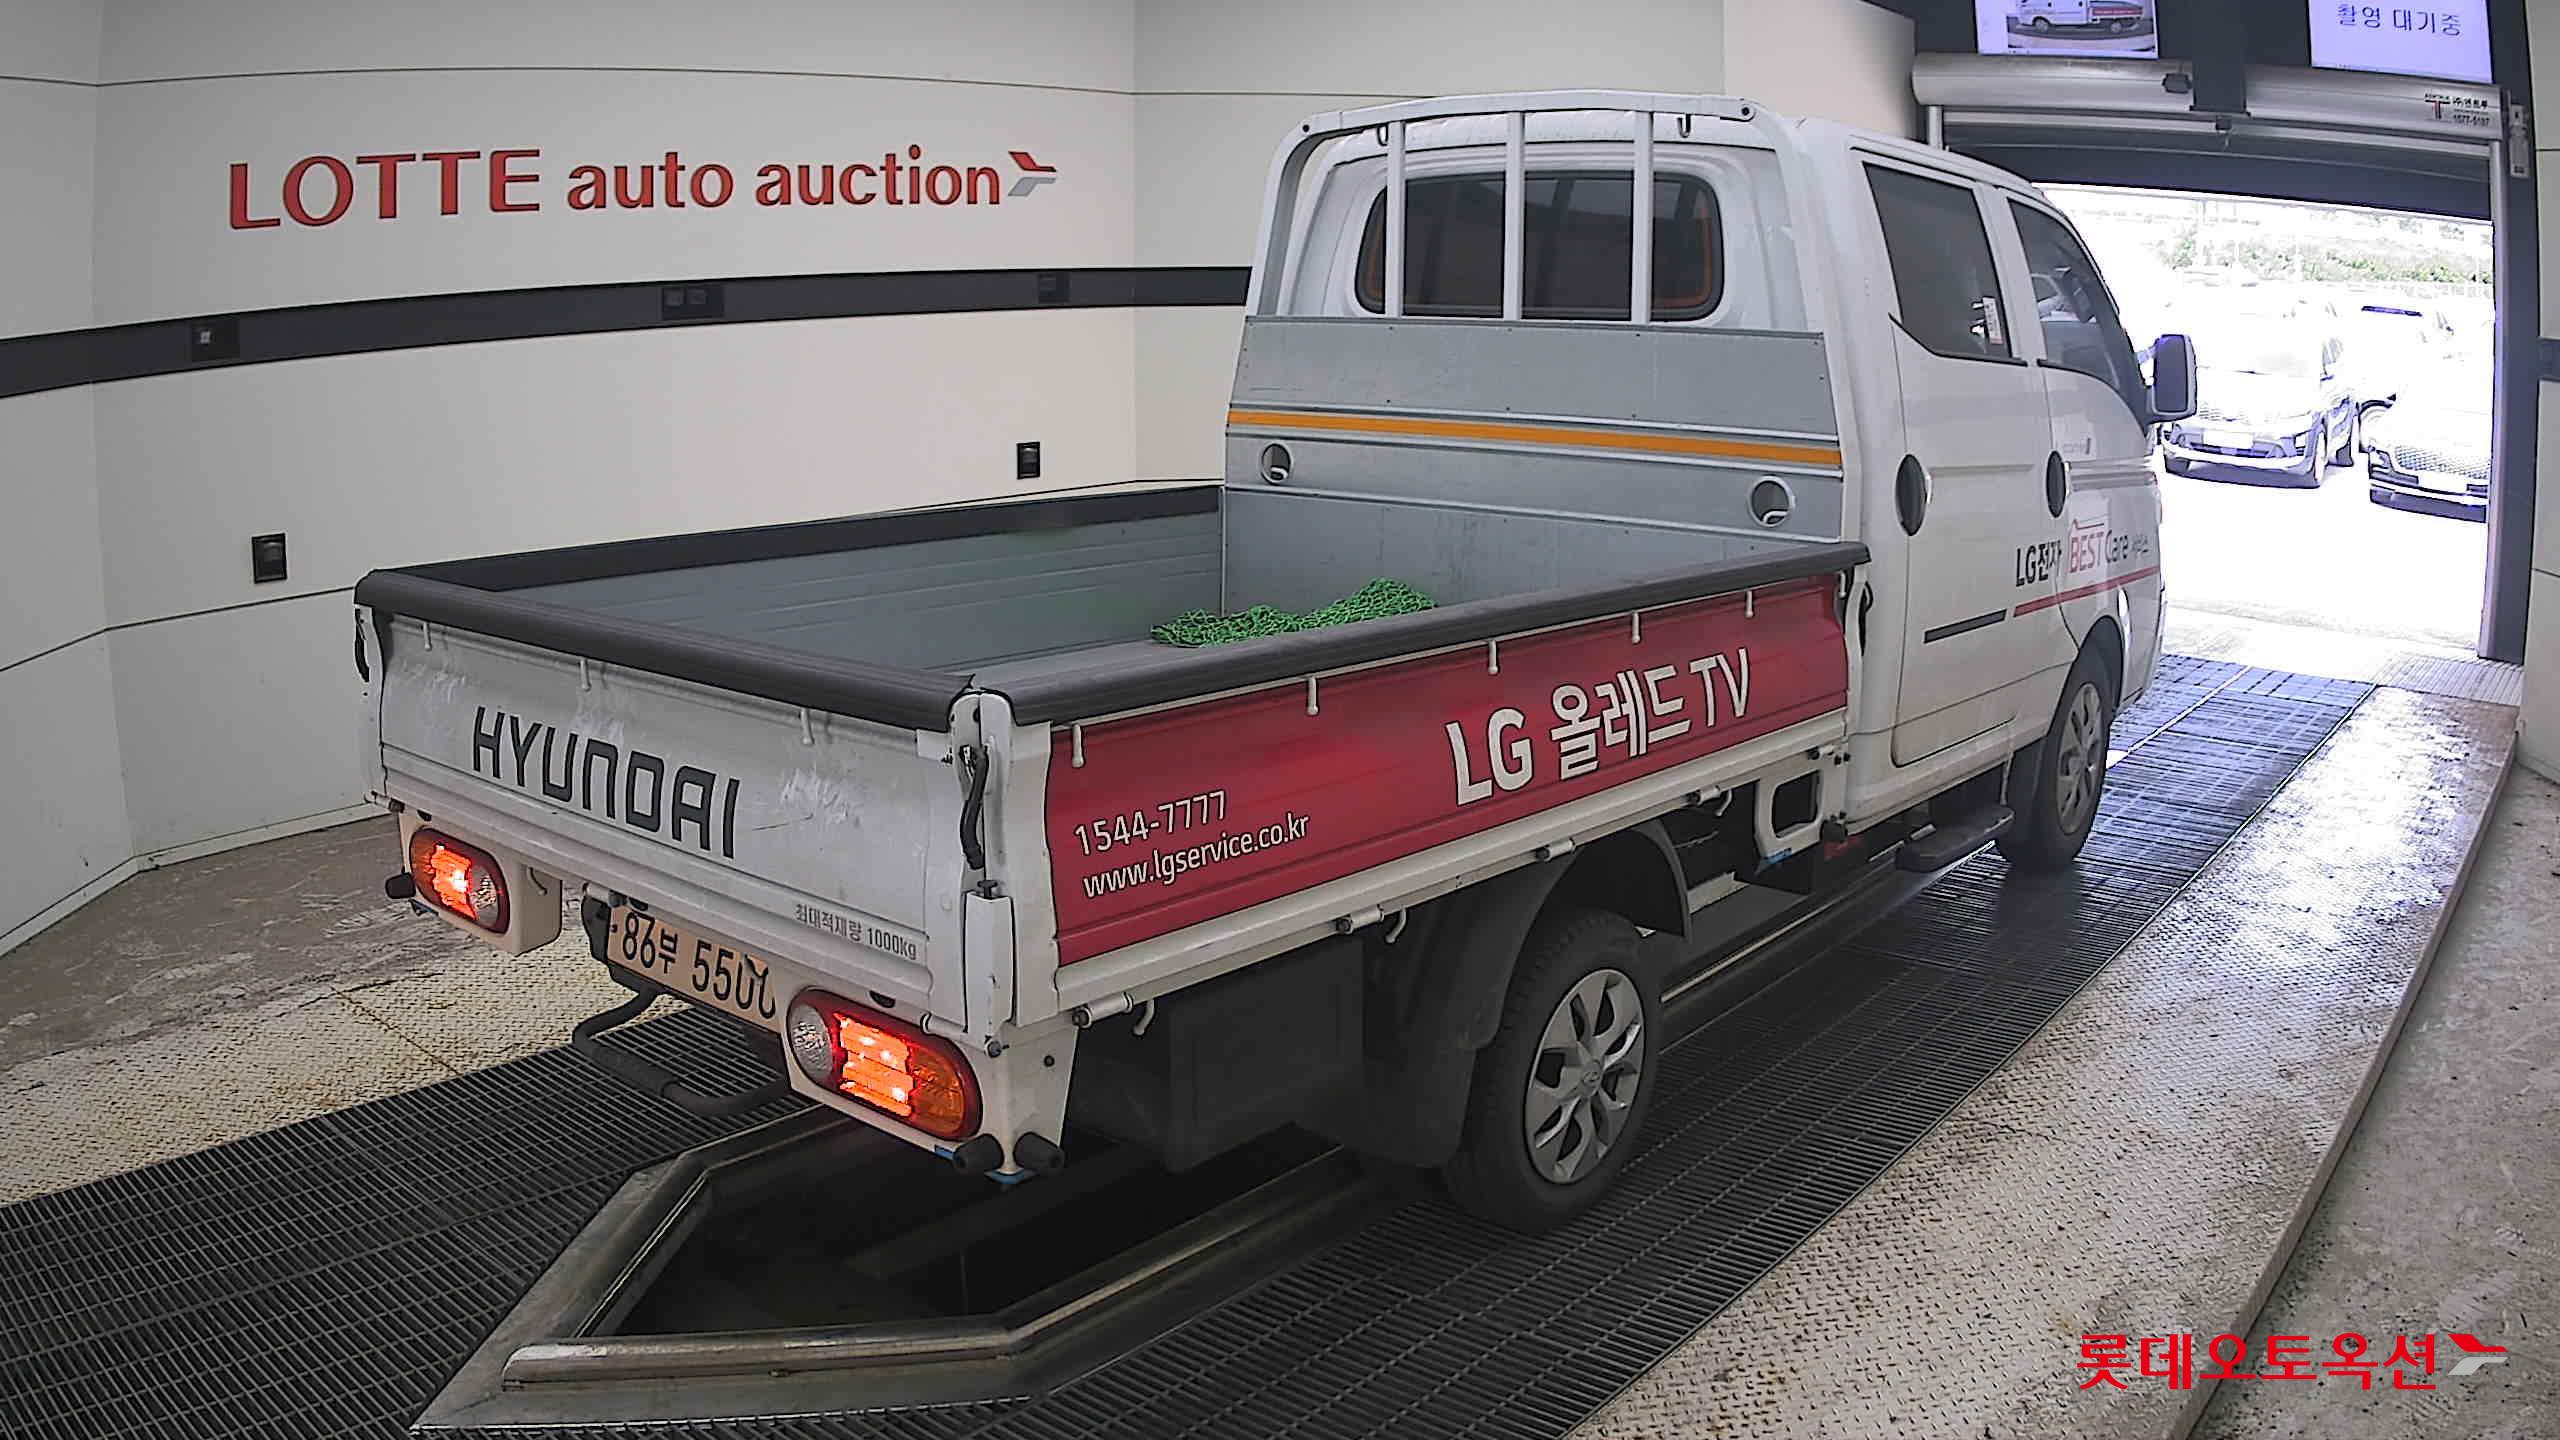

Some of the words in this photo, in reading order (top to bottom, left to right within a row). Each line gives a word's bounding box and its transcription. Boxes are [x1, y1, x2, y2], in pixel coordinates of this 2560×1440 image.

[2393, 9, 2462, 37] 대기중
[231, 151, 538, 229] LOTTE
[568, 153, 735, 209] auto
[756, 146, 1002, 206] auction
[1445, 707, 1533, 806] LG
[1550, 664, 1692, 781] 올레드
[1689, 647, 1749, 728] TV
[473, 705, 741, 859] HYUNDAI
[1074, 789, 1227, 856] 1544-7777
[1082, 812, 1311, 898] www.lgservice.co.kr
[622, 911, 679, 975] 86부
[795, 903, 863, 942] 최대적재량
[867, 927, 917, 961] 1000kg
